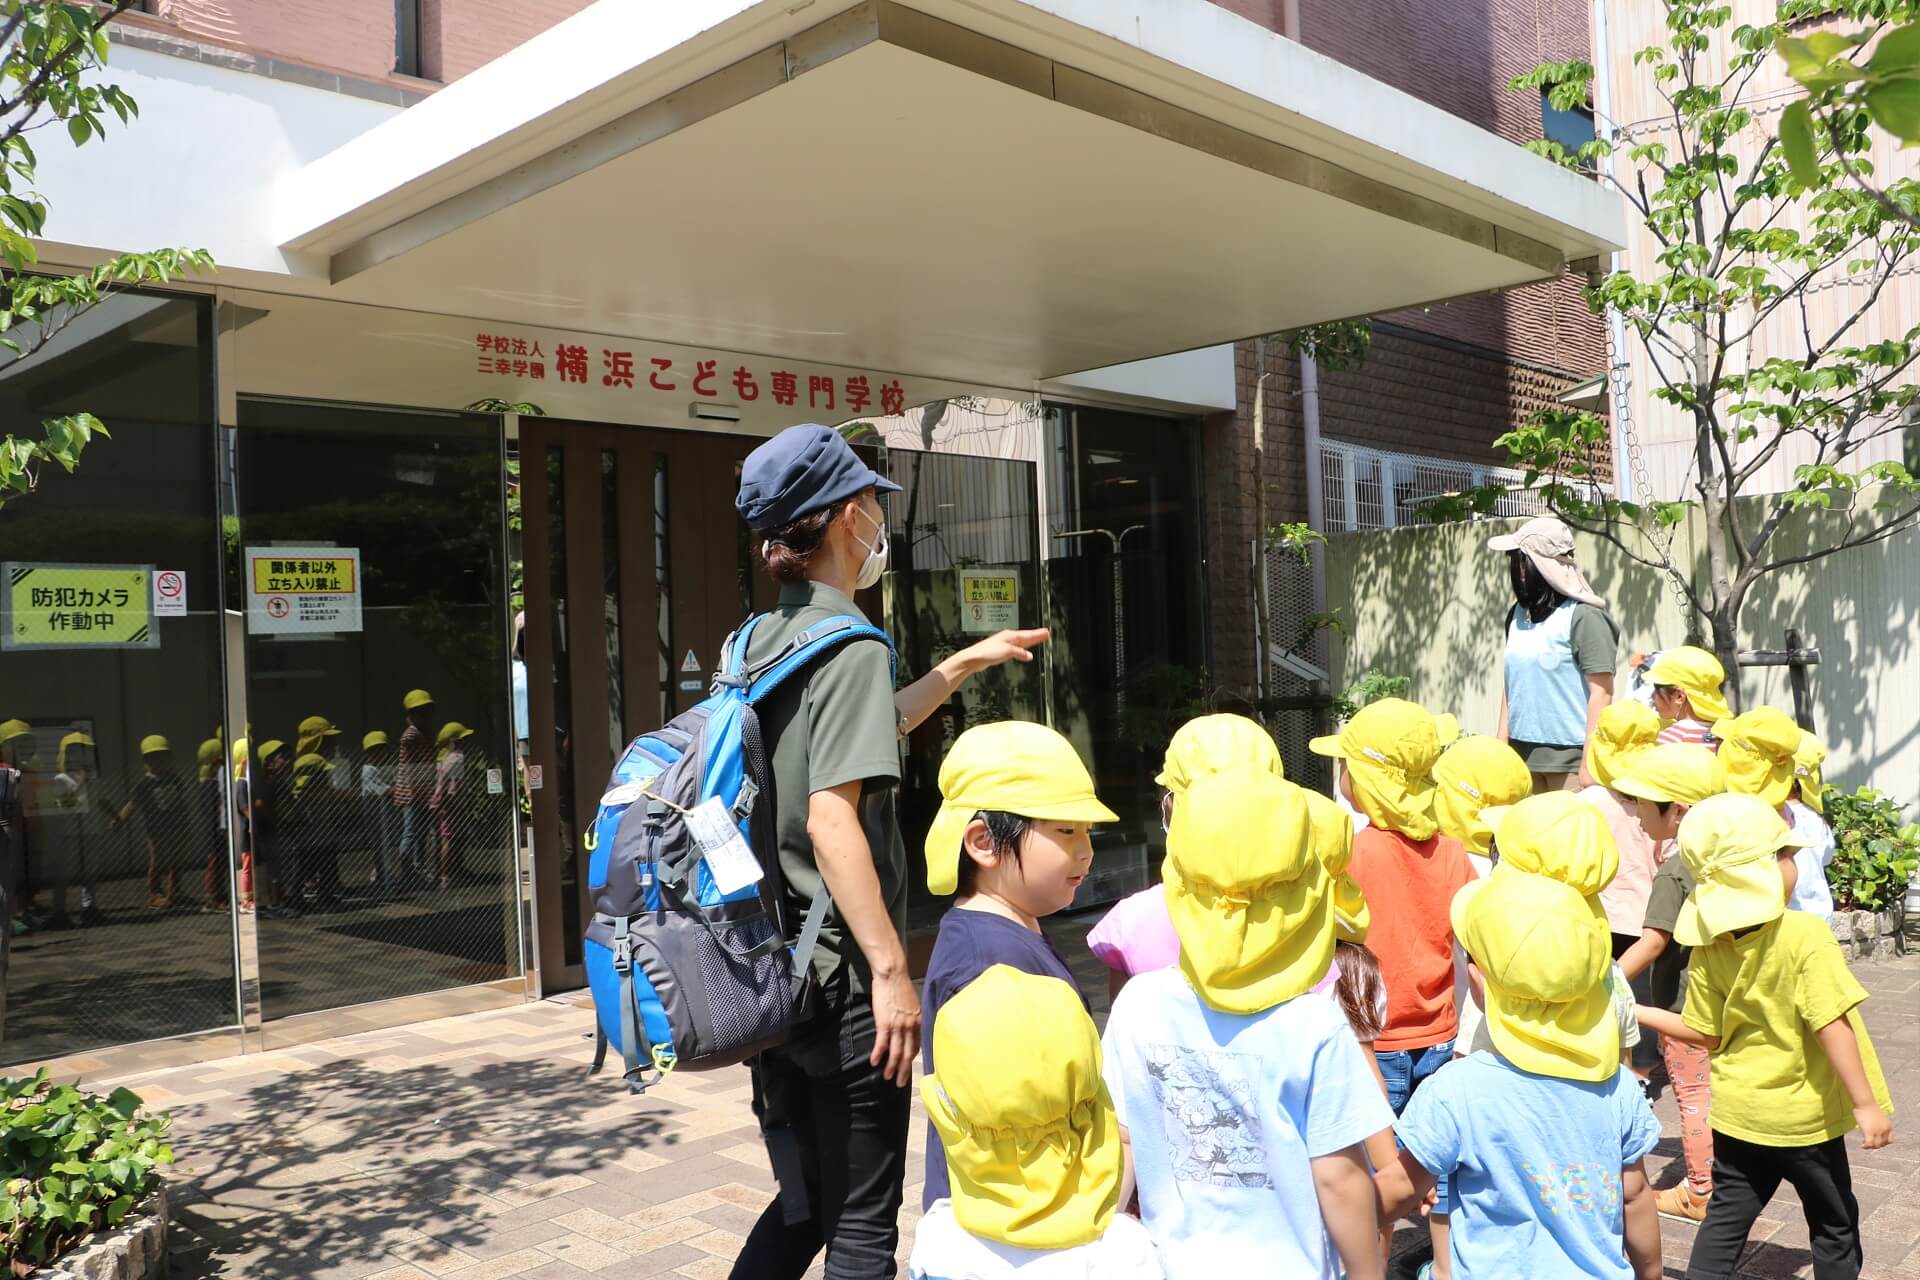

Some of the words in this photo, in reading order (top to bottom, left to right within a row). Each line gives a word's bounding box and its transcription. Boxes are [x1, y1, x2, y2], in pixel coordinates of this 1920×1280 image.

[476, 333, 545, 358] 学校法人
[477, 356, 545, 380] 三幸学園
[555, 343, 906, 417] 横浜こども専門学校
[271, 561, 337, 575] 関係者以外
[268, 577, 342, 591] 立ち入り禁止
[31, 587, 130, 608] 防犯カメラ
[48, 611, 115, 632] 作動中
